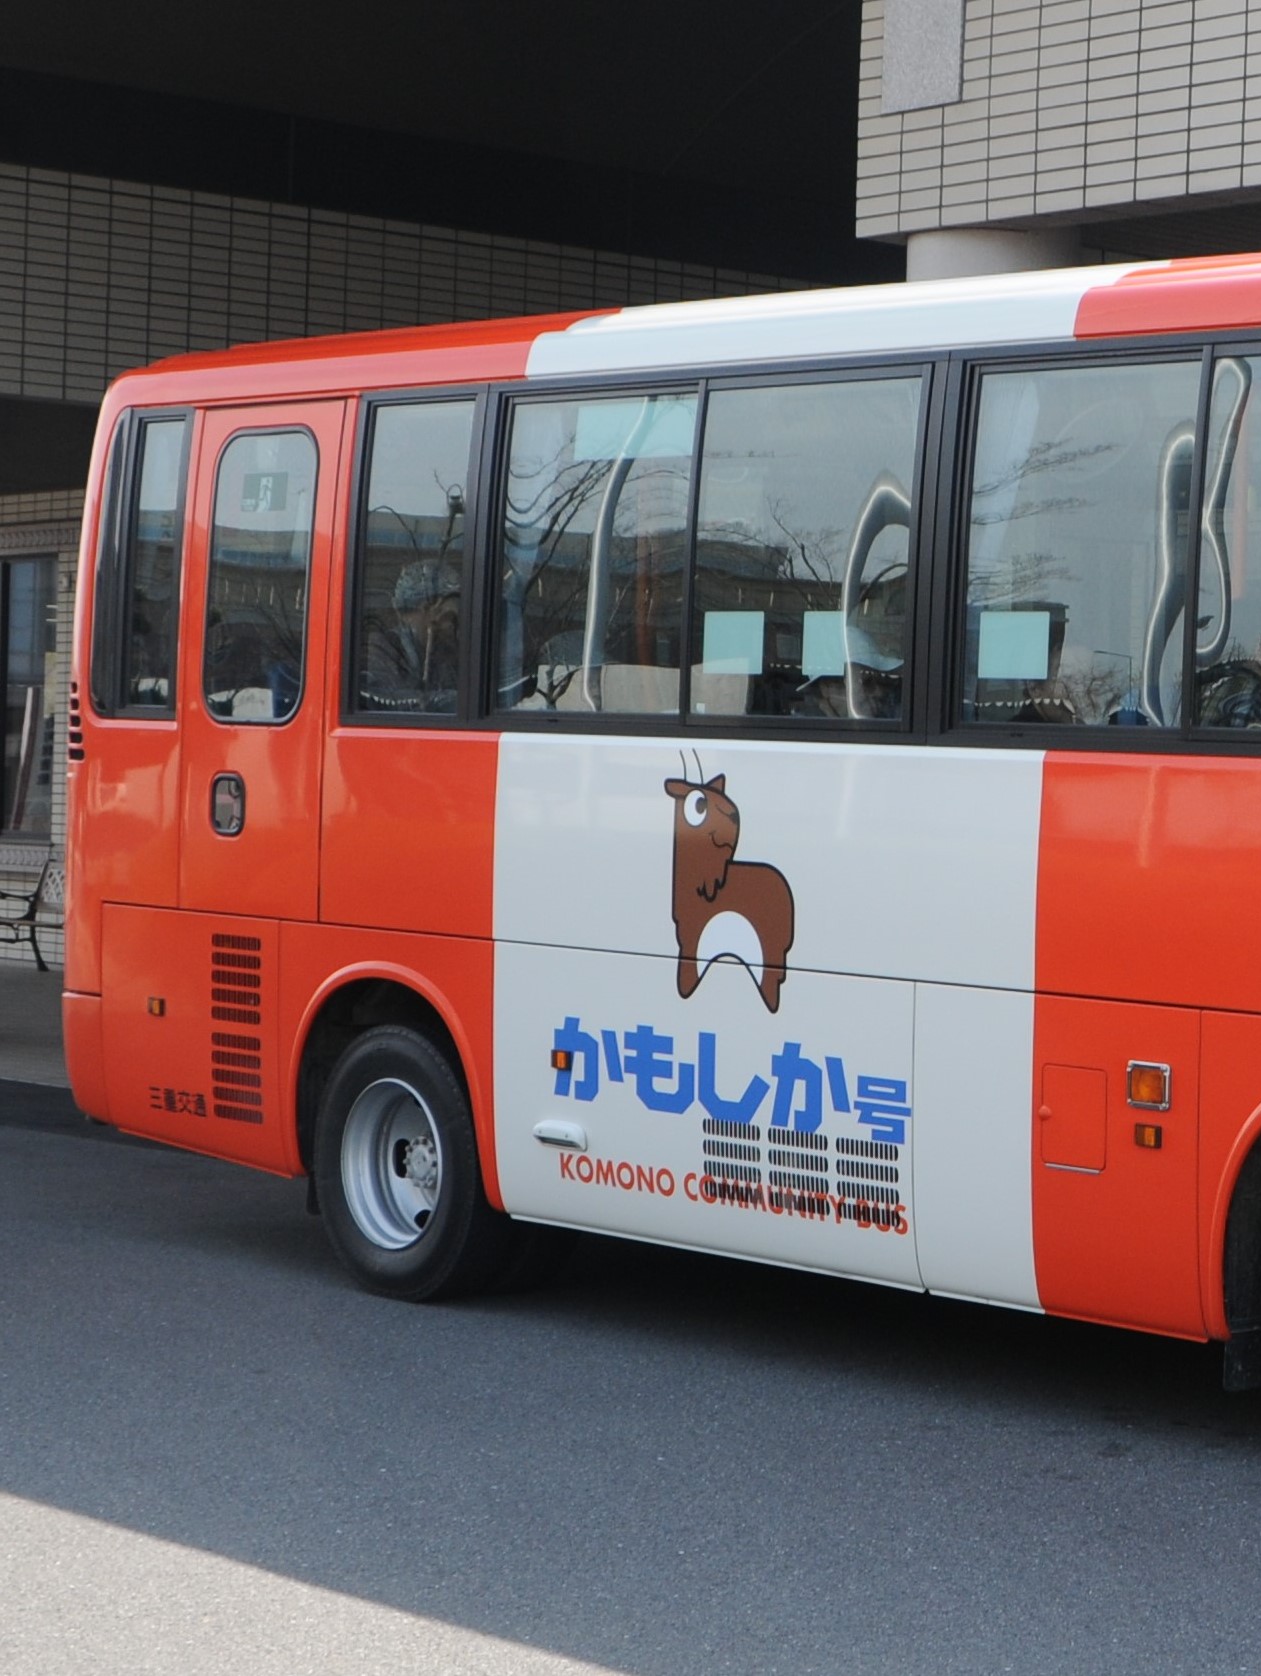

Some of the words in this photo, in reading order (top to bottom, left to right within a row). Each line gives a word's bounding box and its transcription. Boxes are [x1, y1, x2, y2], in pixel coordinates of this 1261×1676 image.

[149, 1086, 207, 1118] 三重交通
[553, 1016, 911, 1145] かもしか号
[559, 1153, 675, 1197] KOMONO
[684, 1172, 846, 1225] COMMUNITY
[856, 1198, 909, 1235] BUS
